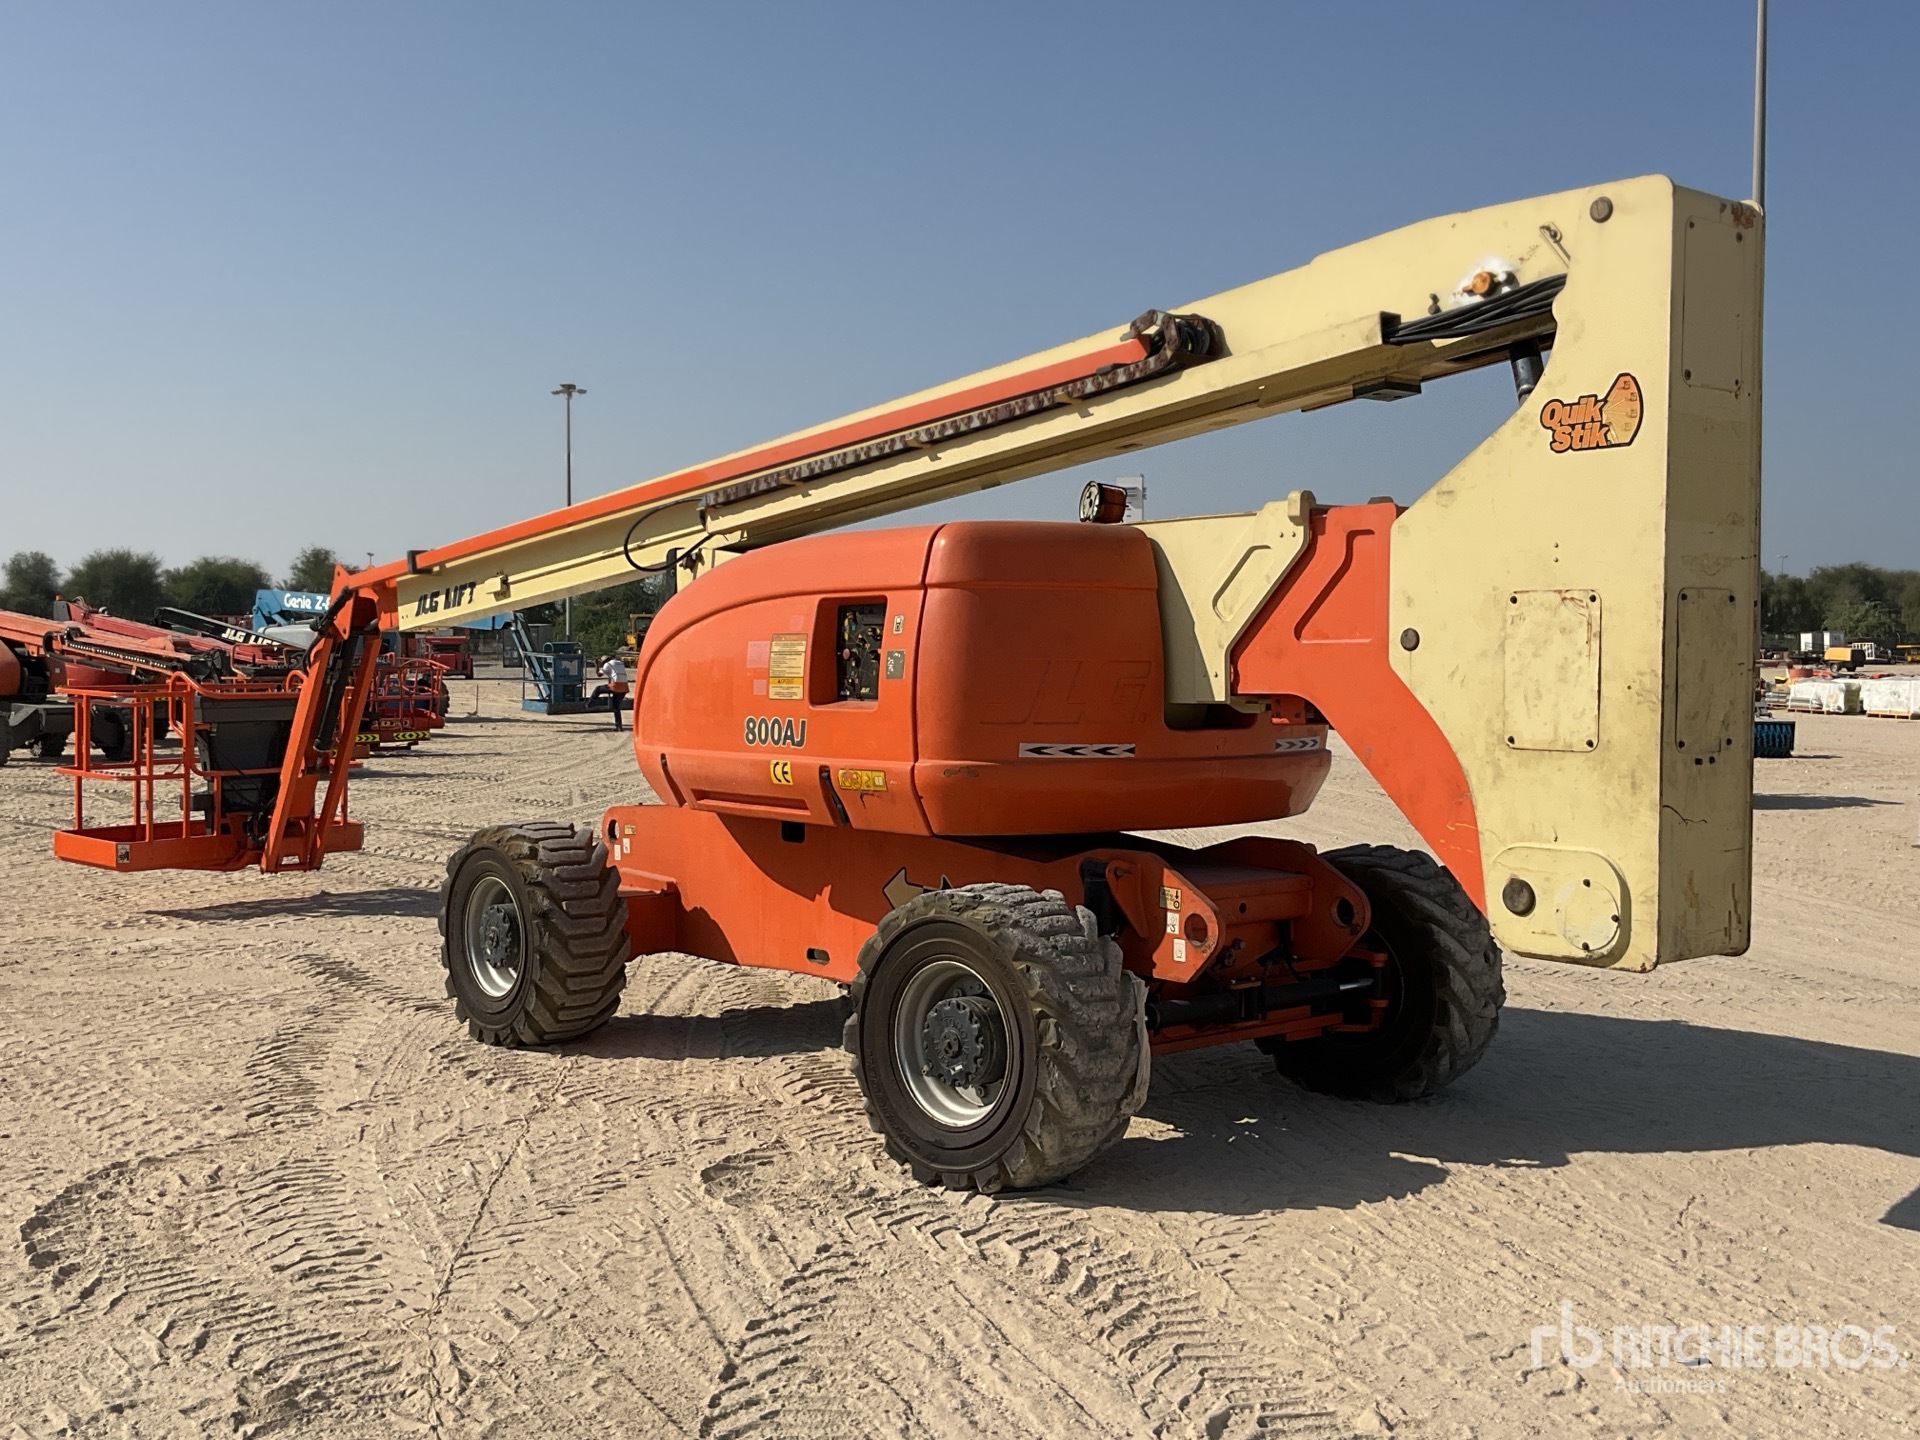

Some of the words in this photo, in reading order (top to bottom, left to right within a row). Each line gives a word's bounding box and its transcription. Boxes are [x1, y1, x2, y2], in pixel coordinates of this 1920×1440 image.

[1541, 396, 1605, 429] Quik
[1551, 421, 1608, 451] Stik
[284, 593, 311, 609] Genie
[415, 590, 440, 617] JLG
[444, 581, 476, 610] LIFT
[221, 627, 246, 643] JLG
[744, 715, 807, 748] 800AJ
[773, 761, 791, 783] CE
